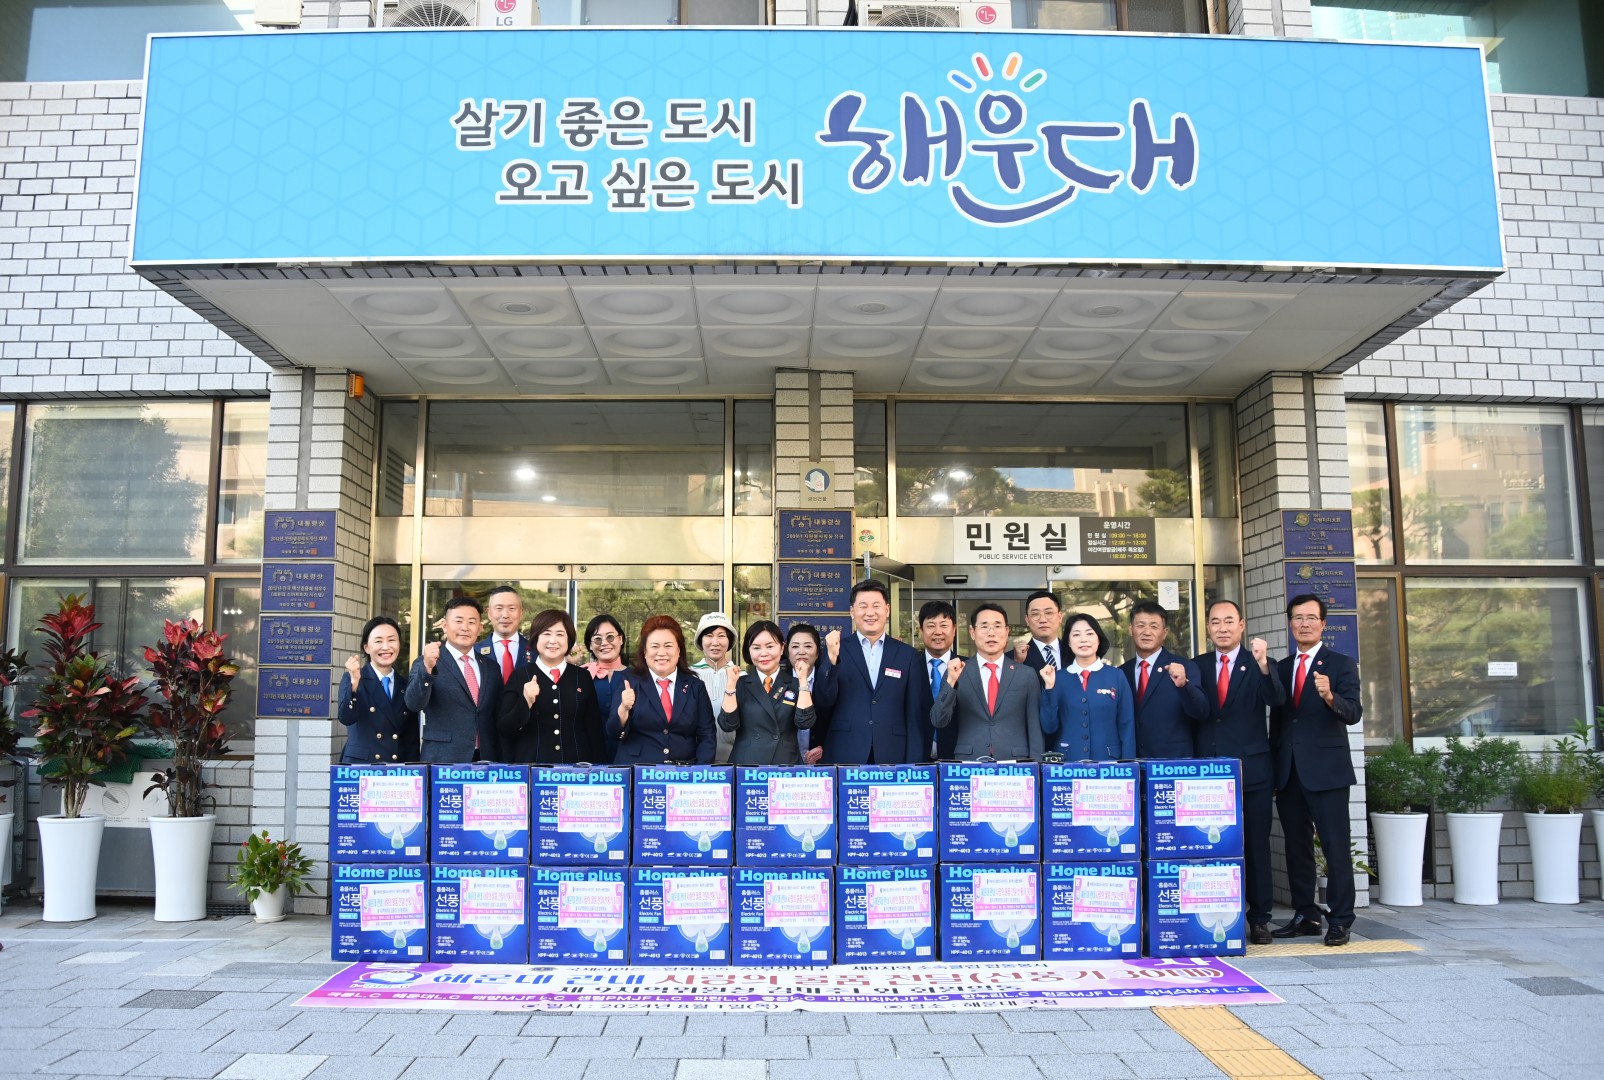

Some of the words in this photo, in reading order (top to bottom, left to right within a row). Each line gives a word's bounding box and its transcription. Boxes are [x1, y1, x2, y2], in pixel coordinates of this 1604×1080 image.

[495, 16, 513, 26] LG
[453, 100, 543, 147] 살기
[559, 99, 649, 147] 좋은
[664, 100, 753, 143] 도시
[499, 161, 589, 202] 오고
[605, 160, 695, 208] 싶은
[709, 162, 800, 205] 도시
[338, 768, 384, 778] Home
[438, 768, 486, 780] Home
[489, 768, 522, 783] plus
[539, 768, 584, 782] Home
[589, 770, 623, 784] plus
[642, 768, 689, 780] Home
[693, 768, 727, 783] plus
[745, 769, 792, 780] Home
[796, 770, 829, 778] plus
[846, 768, 894, 780] Home
[897, 768, 930, 783] plus
[948, 766, 995, 777] Home
[999, 766, 1032, 777] plus
[1050, 766, 1097, 778] Home
[1100, 765, 1133, 779] plus
[1152, 764, 1197, 776] Home
[1200, 763, 1232, 778] plus
[338, 794, 359, 807] 선풍
[439, 795, 462, 808] 선풍
[642, 796, 666, 809] 선풍
[745, 796, 768, 809] 선풍
[847, 796, 869, 809] 선풍
[949, 792, 970, 805] 선풍
[1052, 793, 1072, 806] 선풍
[1154, 791, 1174, 803] 선풍
[339, 866, 384, 878] Home
[388, 866, 422, 880] plus
[436, 867, 482, 878] Home
[485, 867, 518, 878] plus
[537, 870, 584, 882] Home
[588, 870, 622, 882] plus
[639, 870, 686, 881] Home
[740, 870, 788, 881] Home
[791, 870, 826, 880] plus
[844, 868, 892, 880] Home
[895, 868, 928, 882] plus
[1051, 866, 1098, 877] Home
[1102, 865, 1134, 878] plus
[339, 894, 360, 906] 선풍
[436, 894, 459, 907] 선풍
[844, 895, 866, 908] 선풍
[950, 894, 973, 906] 선풍
[1052, 892, 1073, 905] 선풍
[1158, 889, 1179, 902] 선풍
[538, 897, 558, 910] 선풍
[639, 897, 662, 910] 선풍
[741, 897, 764, 910] 선풍
[433, 973, 554, 984] 해운대
[566, 975, 645, 985] 관내
[656, 974, 778, 985] 사랑의
[794, 975, 870, 986] 물품
